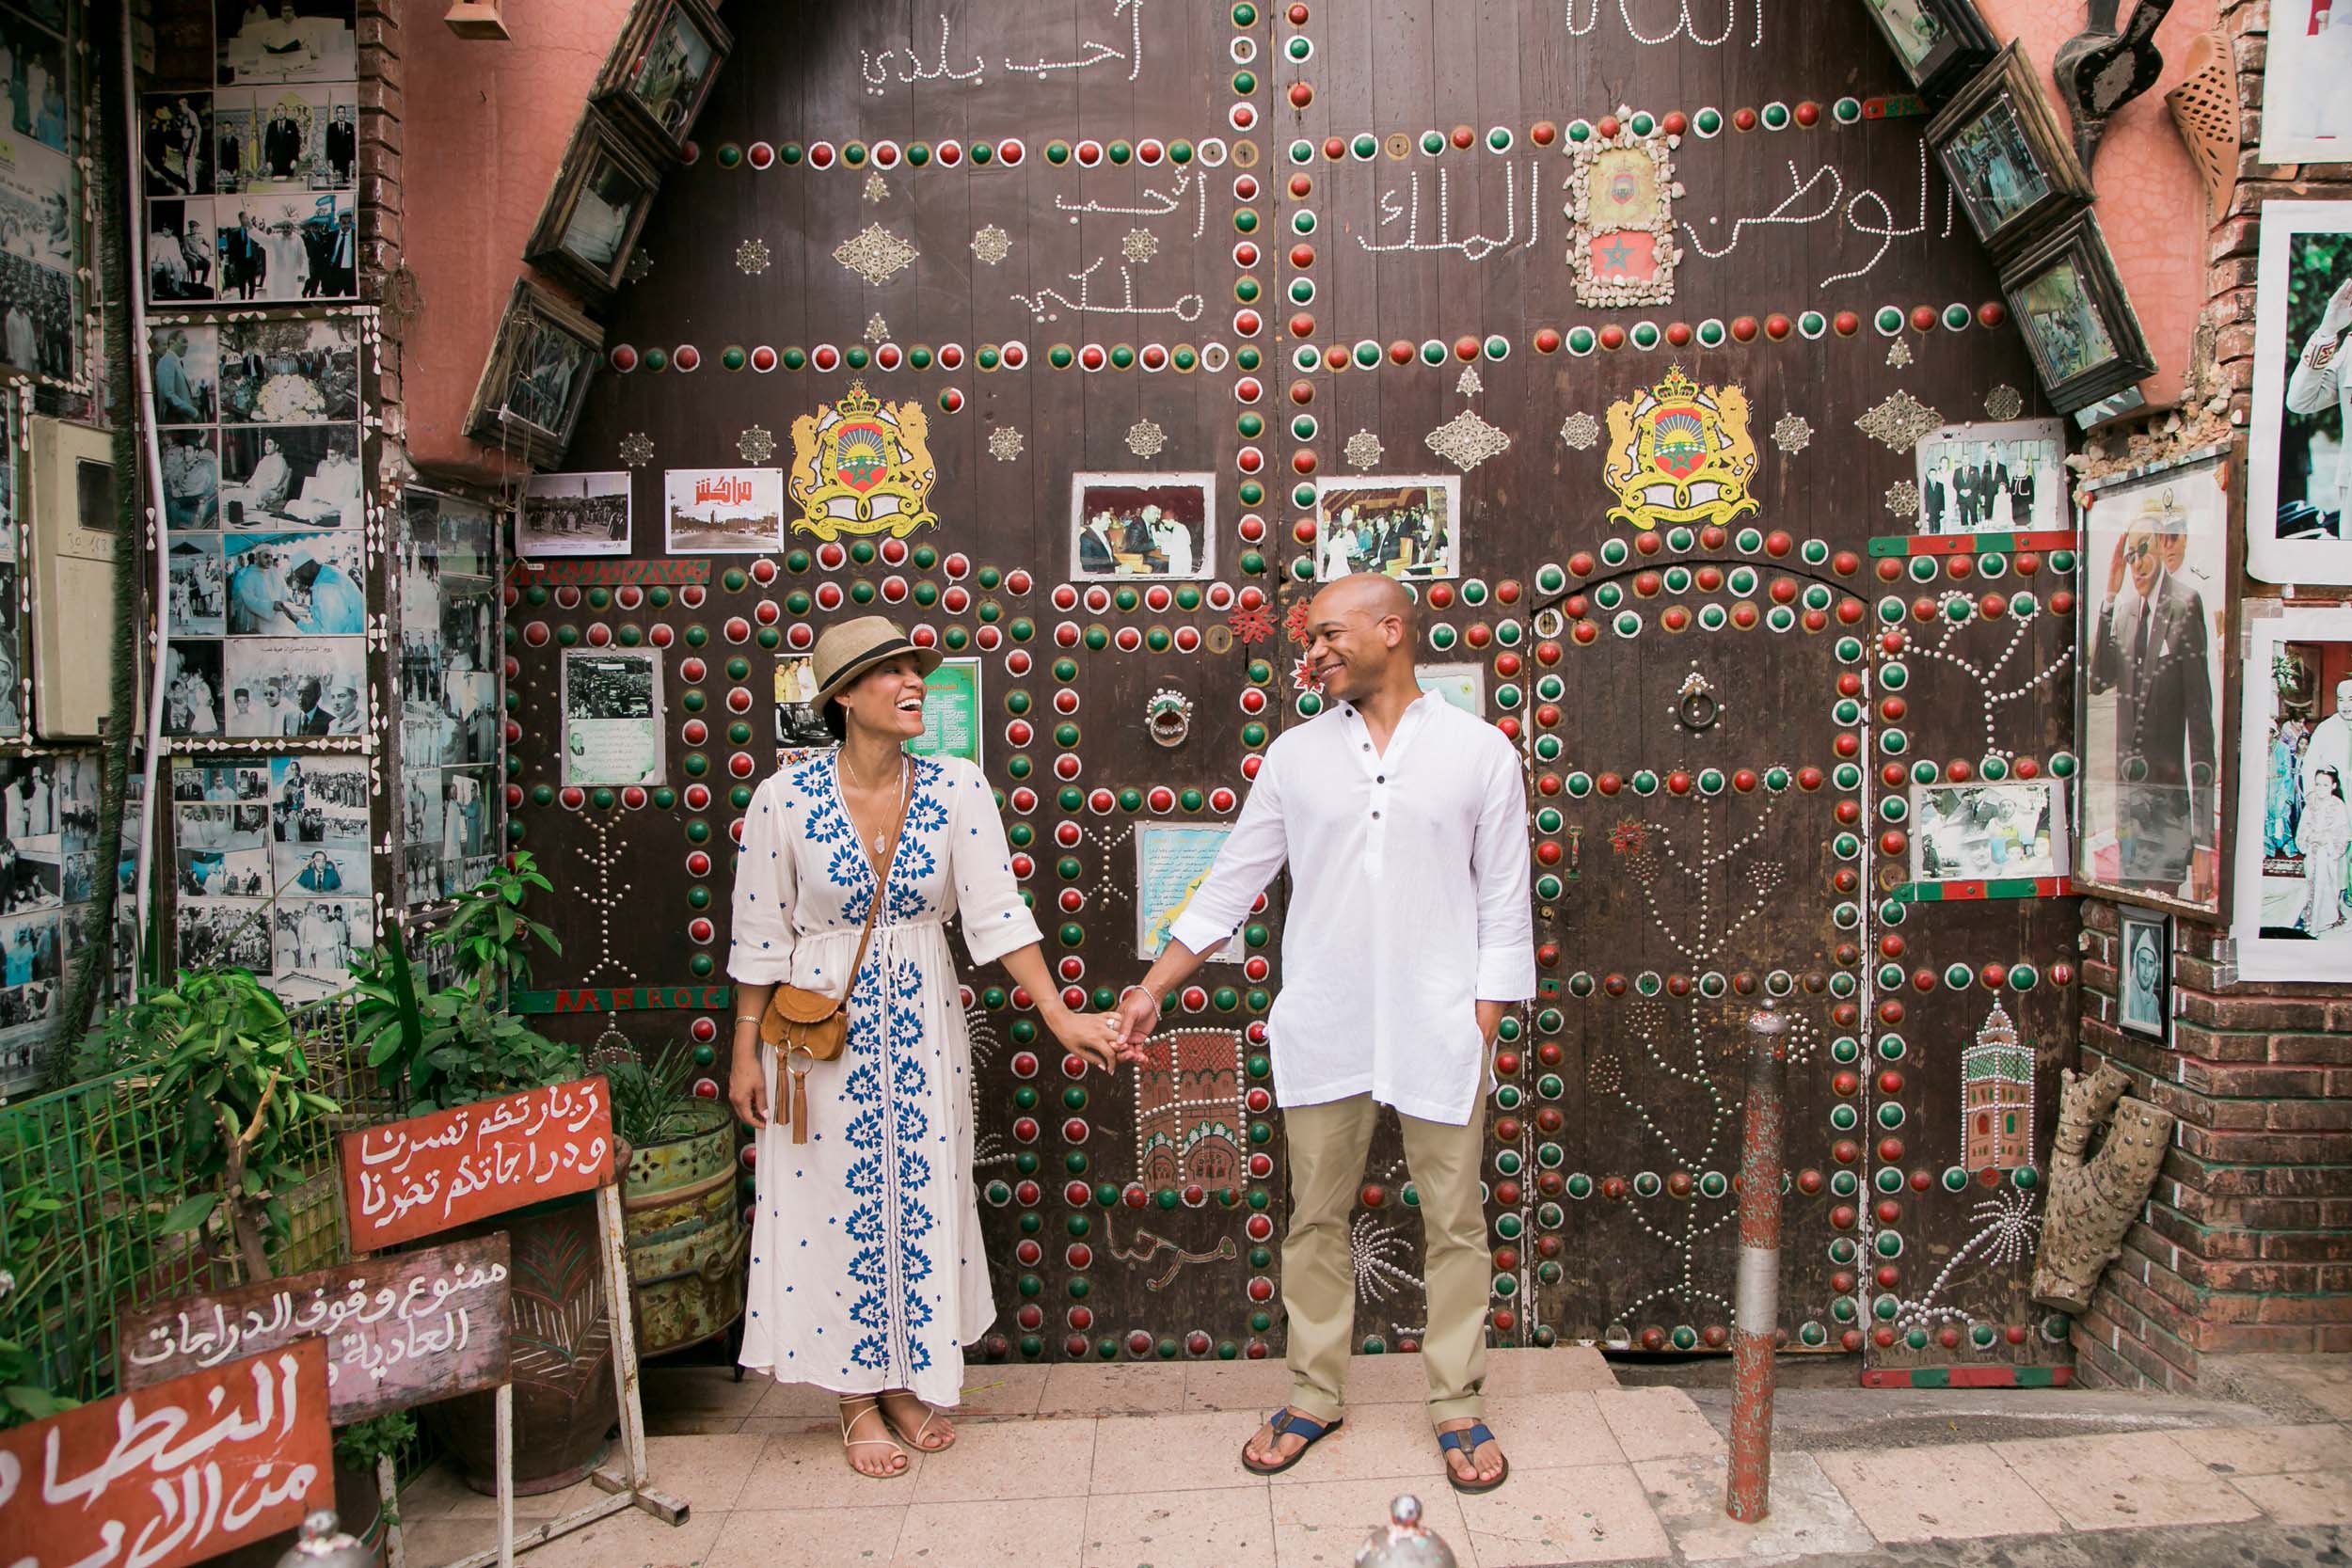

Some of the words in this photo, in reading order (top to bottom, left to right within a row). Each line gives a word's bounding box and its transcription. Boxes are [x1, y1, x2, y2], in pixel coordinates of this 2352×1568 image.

[694, 475, 753, 506] مراكش
[554, 987, 719, 1014] MAROC
[1104, 1212, 1237, 1291] مرحبا
[295, 1278, 396, 1335] وقوف
[398, 1262, 507, 1320] ممنوع
[130, 1291, 292, 1368] الدراجات
[342, 1307, 469, 1380] العادية
[222, 1463, 318, 1532] من
